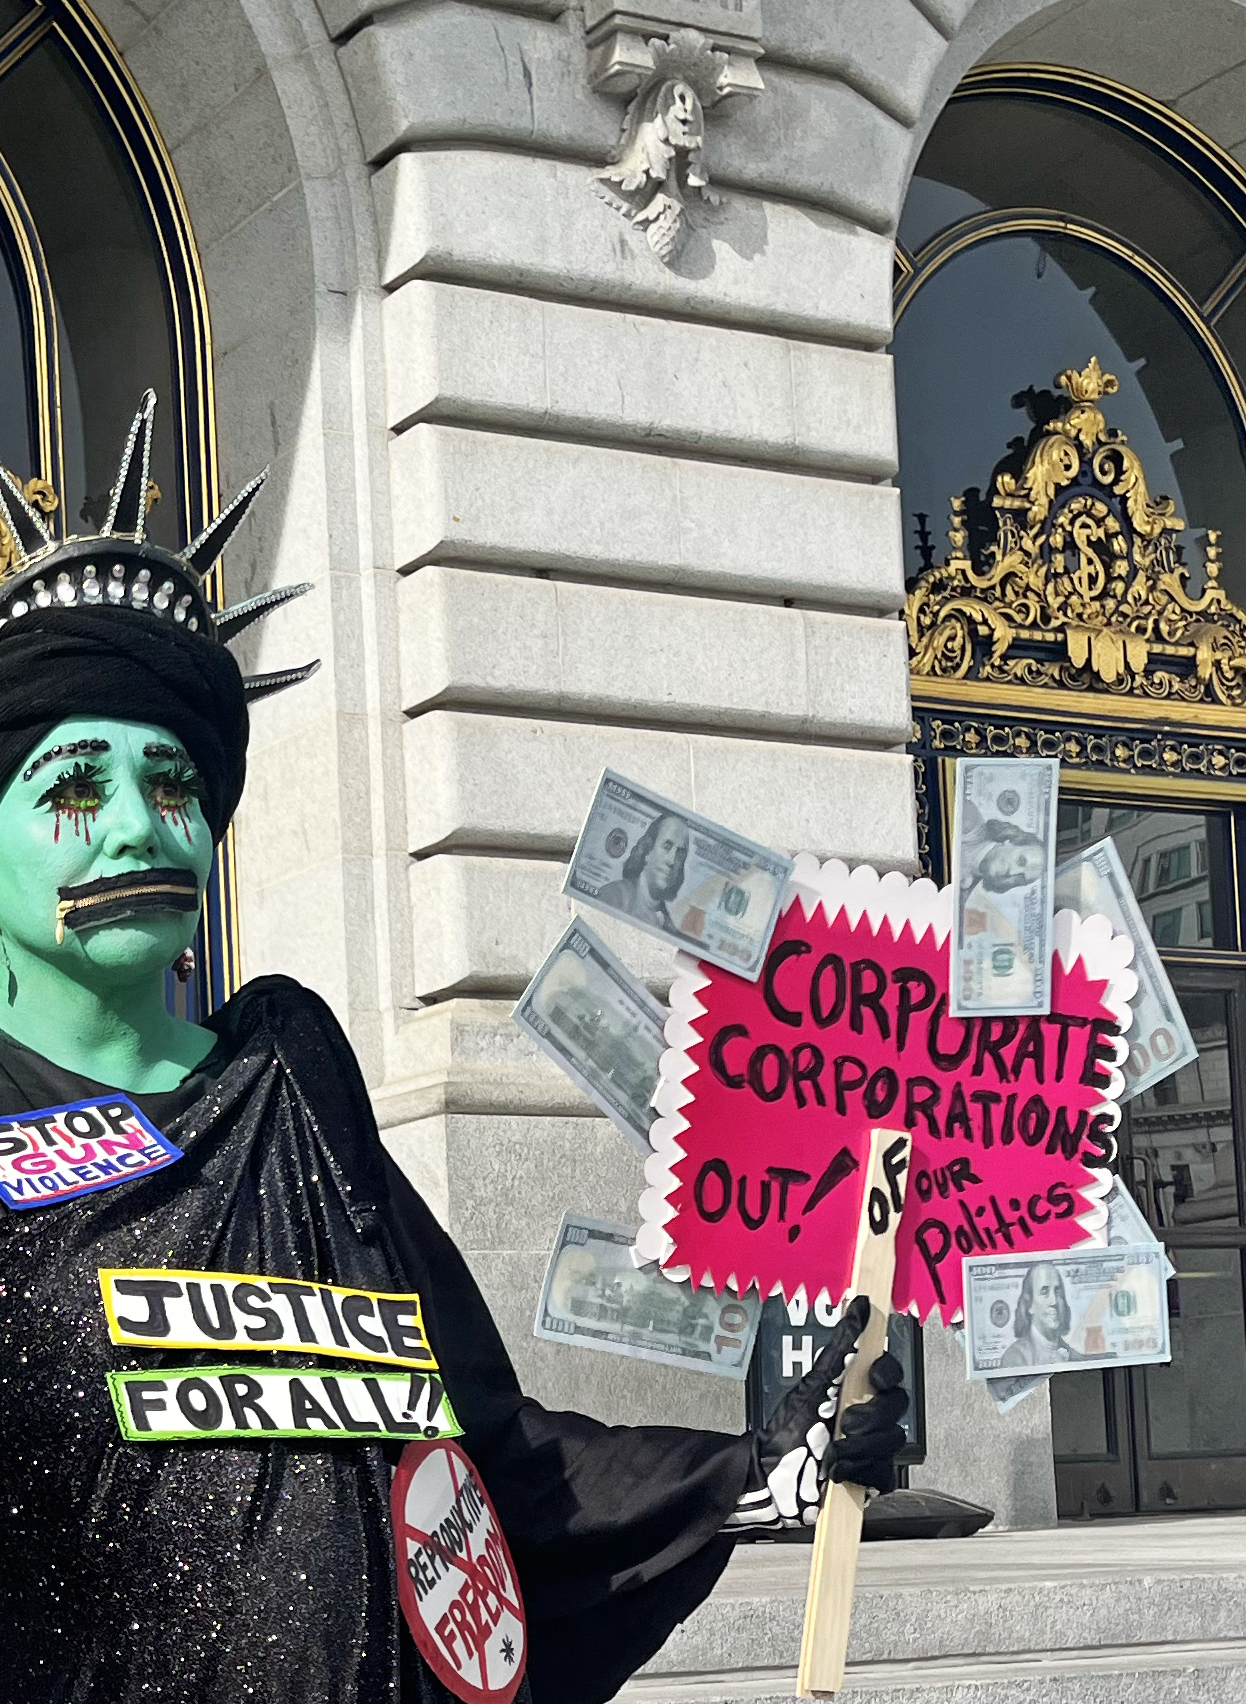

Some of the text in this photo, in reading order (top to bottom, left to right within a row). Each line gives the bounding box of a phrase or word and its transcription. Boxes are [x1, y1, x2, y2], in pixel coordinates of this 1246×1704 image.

[708, 1024, 1116, 1168] CORPORATIONS
[3, 1144, 169, 1196] VIOLENCE
[11, 1133, 145, 1174] GUN
[694, 1147, 859, 1243] OUT!
[915, 1157, 983, 1201] OUR
[115, 1280, 432, 1360] JUSTICE
[125, 1373, 444, 1438] FOR ALL!!
